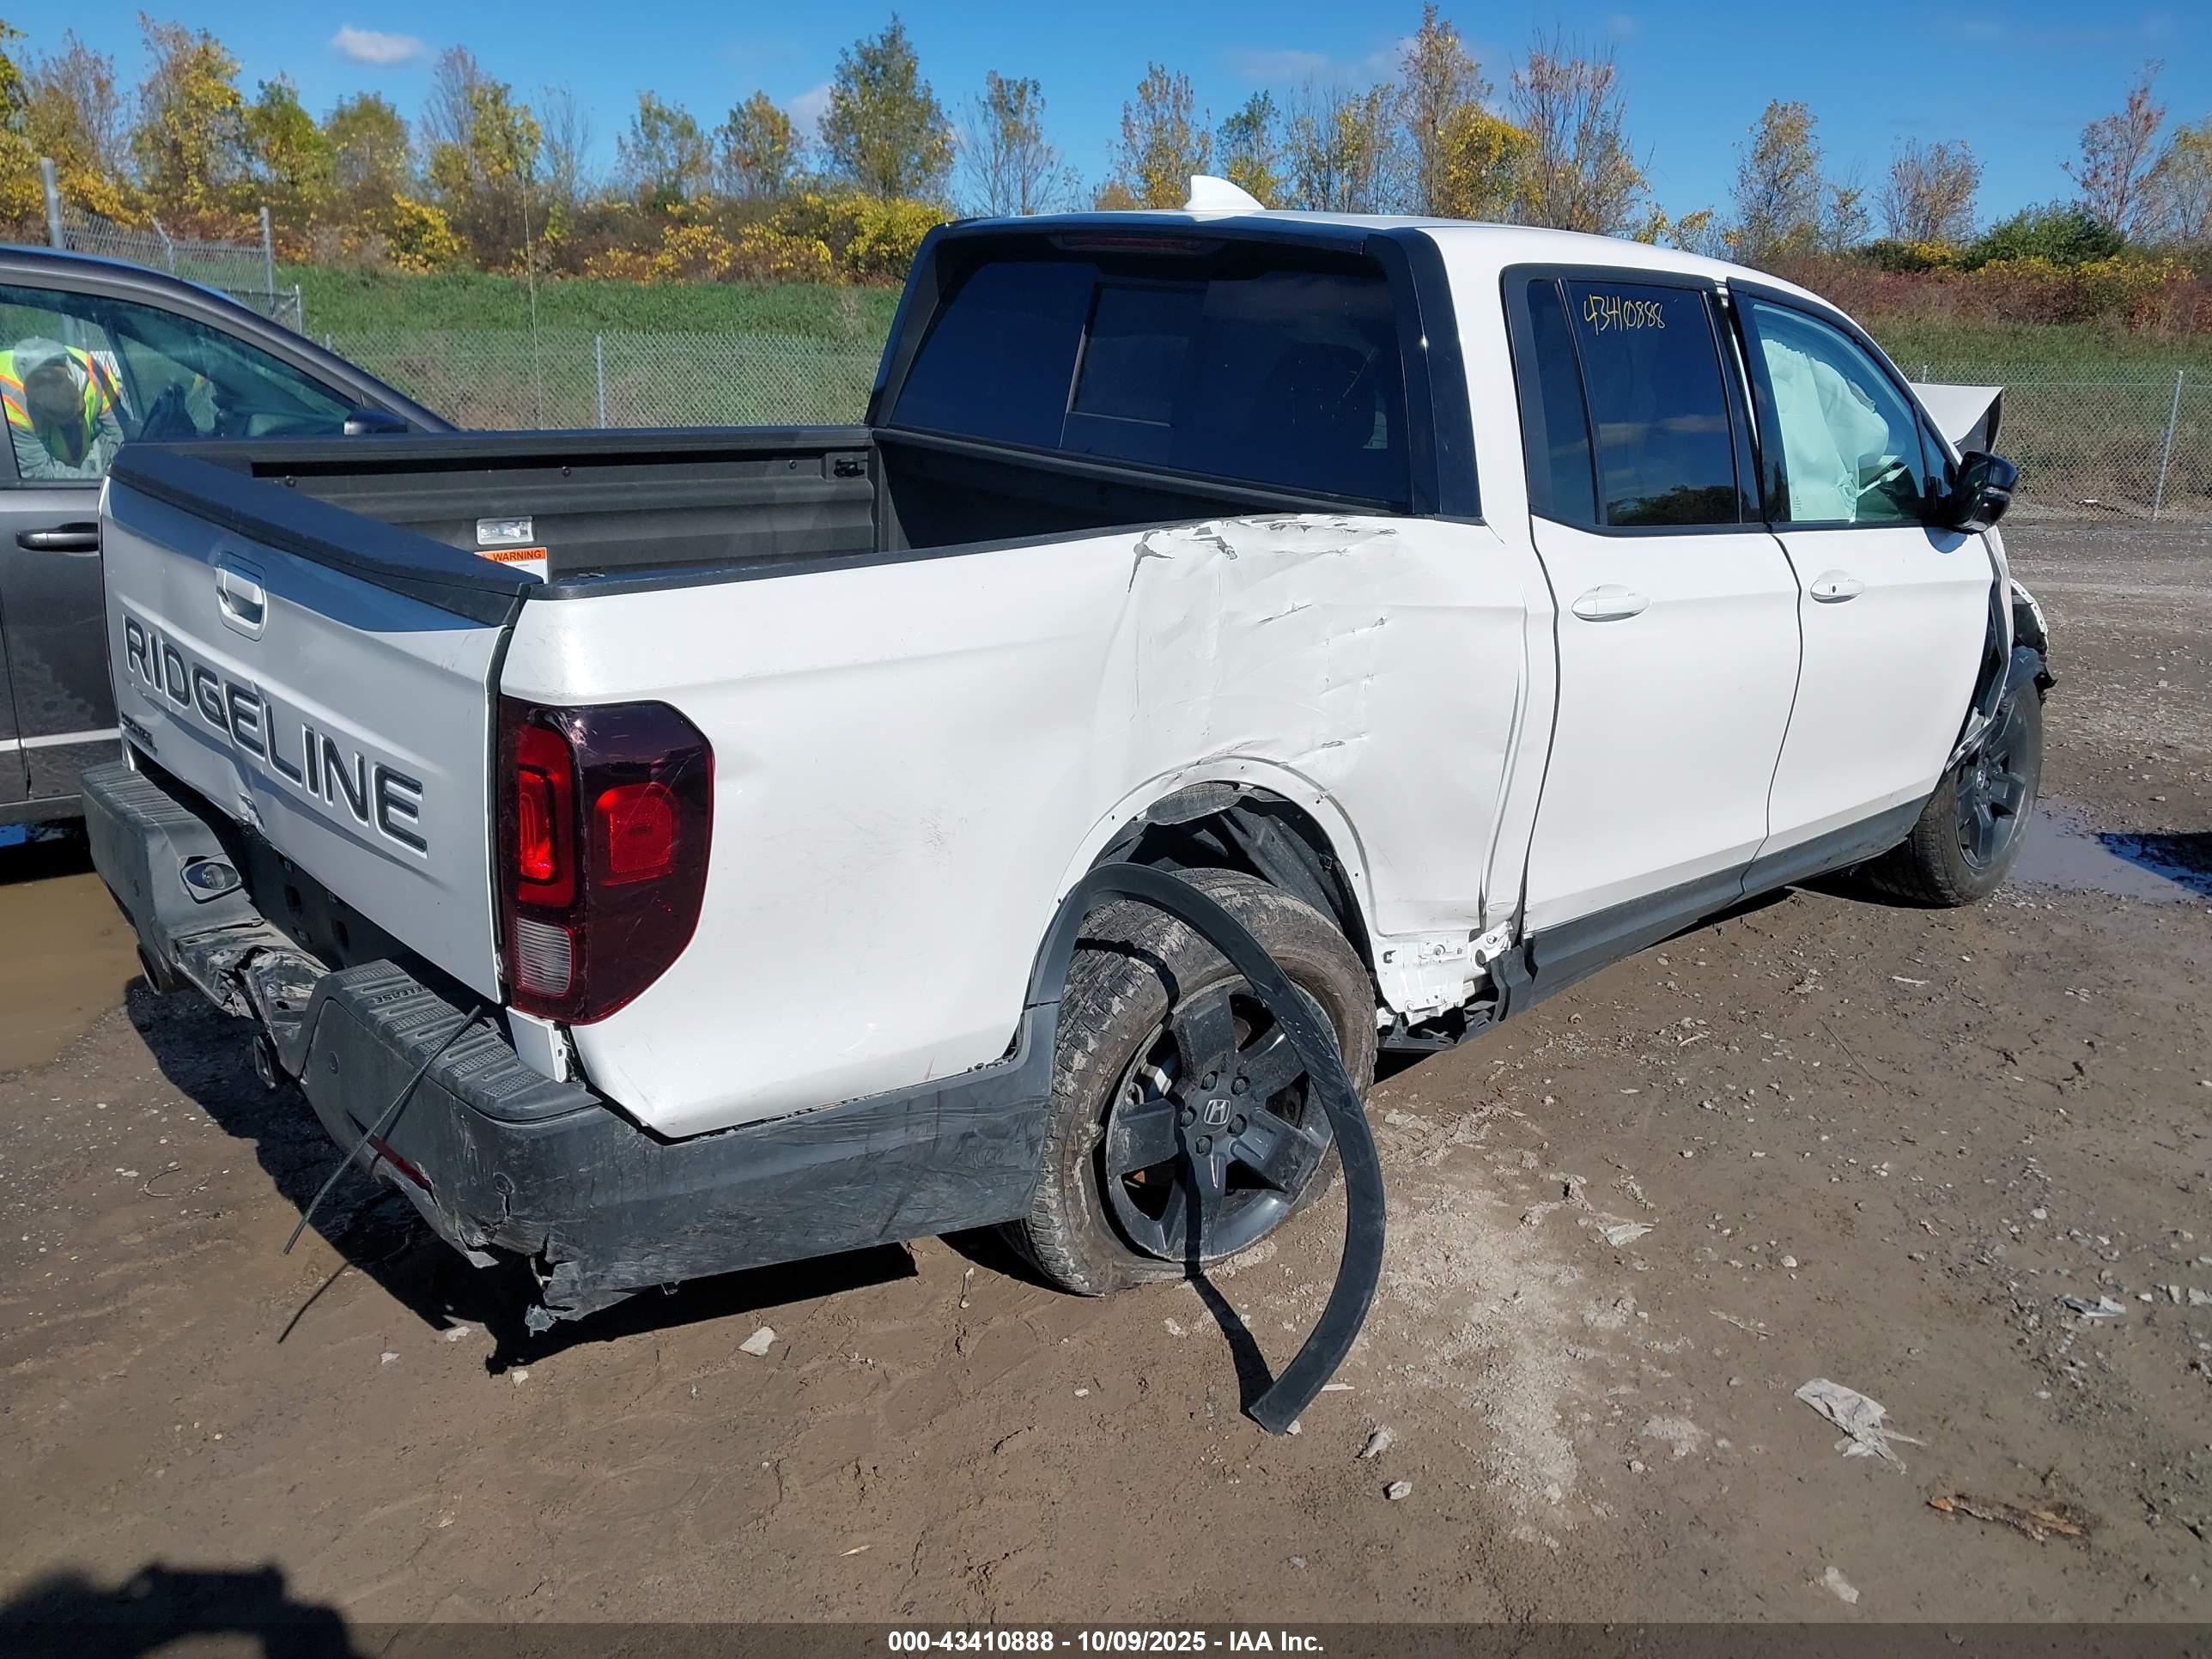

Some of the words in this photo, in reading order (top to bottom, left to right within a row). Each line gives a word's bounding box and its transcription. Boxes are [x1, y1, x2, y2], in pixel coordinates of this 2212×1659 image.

[1583, 294, 1666, 336] 43410888
[493, 550, 542, 562] WARNING
[122, 612, 428, 859] RIDGELINE
